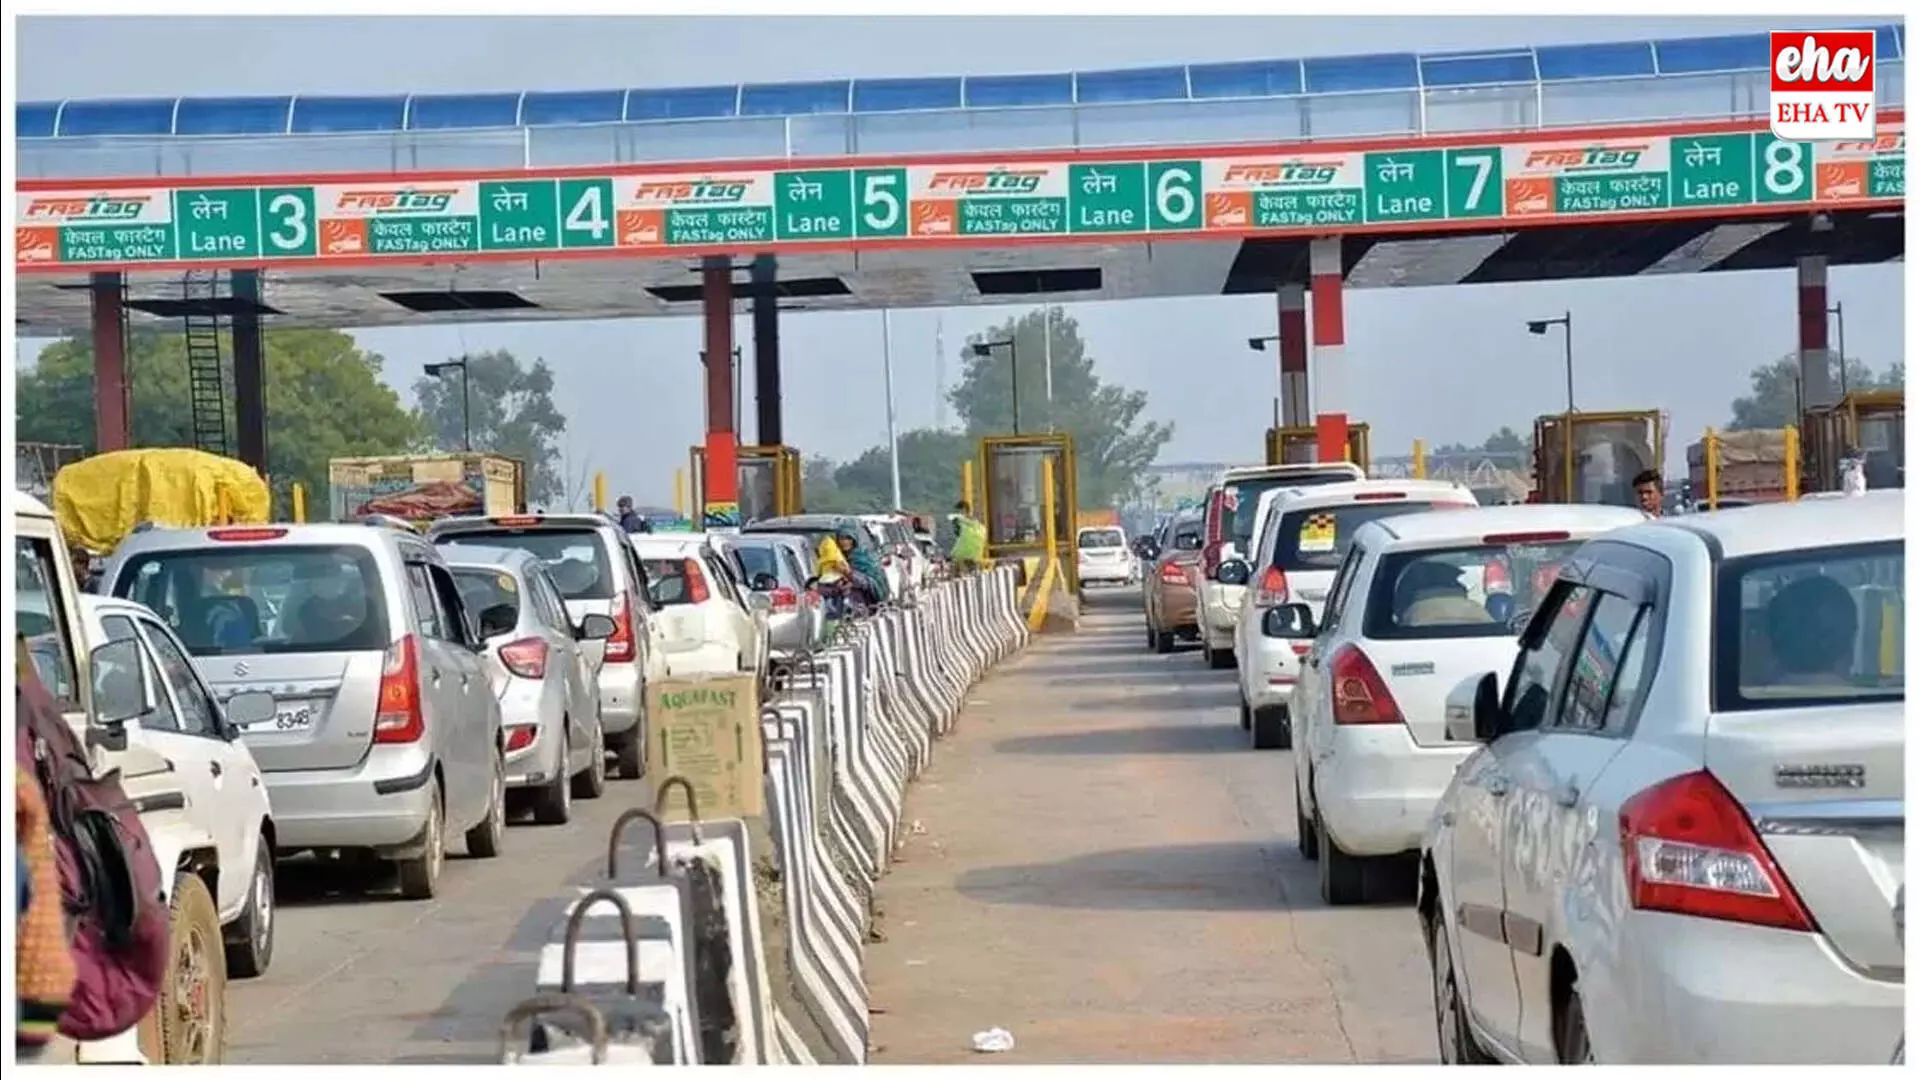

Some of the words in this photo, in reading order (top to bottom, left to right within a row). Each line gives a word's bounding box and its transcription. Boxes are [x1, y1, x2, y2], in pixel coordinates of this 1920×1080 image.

[1684, 142, 1721, 167] लेन
[1377, 158, 1414, 183] लेन
[1764, 139, 1804, 194] 8
[788, 177, 822, 201] लेन
[1082, 168, 1116, 194] लेन
[1455, 156, 1493, 210] 7
[1561, 178, 1600, 195] केवल
[1684, 178, 1740, 199] Lane
[492, 187, 528, 212] लेन
[863, 175, 900, 230] 5
[1156, 168, 1195, 223] 6
[1259, 193, 1298, 209] केवल
[1378, 195, 1432, 214] Lane
[1563, 197, 1616, 210] FASTag
[1620, 194, 1660, 208] ONLY
[190, 194, 228, 219] लेन
[565, 186, 609, 239] 4
[964, 201, 1001, 217] केवल
[1082, 206, 1134, 225] Lane
[269, 194, 308, 249] 3
[671, 211, 708, 227] केवल
[788, 214, 840, 233] Lane
[966, 220, 1017, 233] FASTag
[1021, 219, 1058, 230] ONLY
[1261, 213, 1312, 226] FASTag
[1317, 211, 1355, 222] ONLY
[65, 228, 105, 244] केवल
[374, 221, 413, 237] केवल
[493, 224, 546, 243] Lane
[672, 230, 724, 243] FASTag
[727, 228, 765, 240] ONLY
[192, 232, 245, 251] Lane
[377, 240, 428, 252] FASTag
[432, 238, 470, 249] ONLY
[68, 246, 120, 260] FASTag
[125, 245, 164, 257] ONLY
